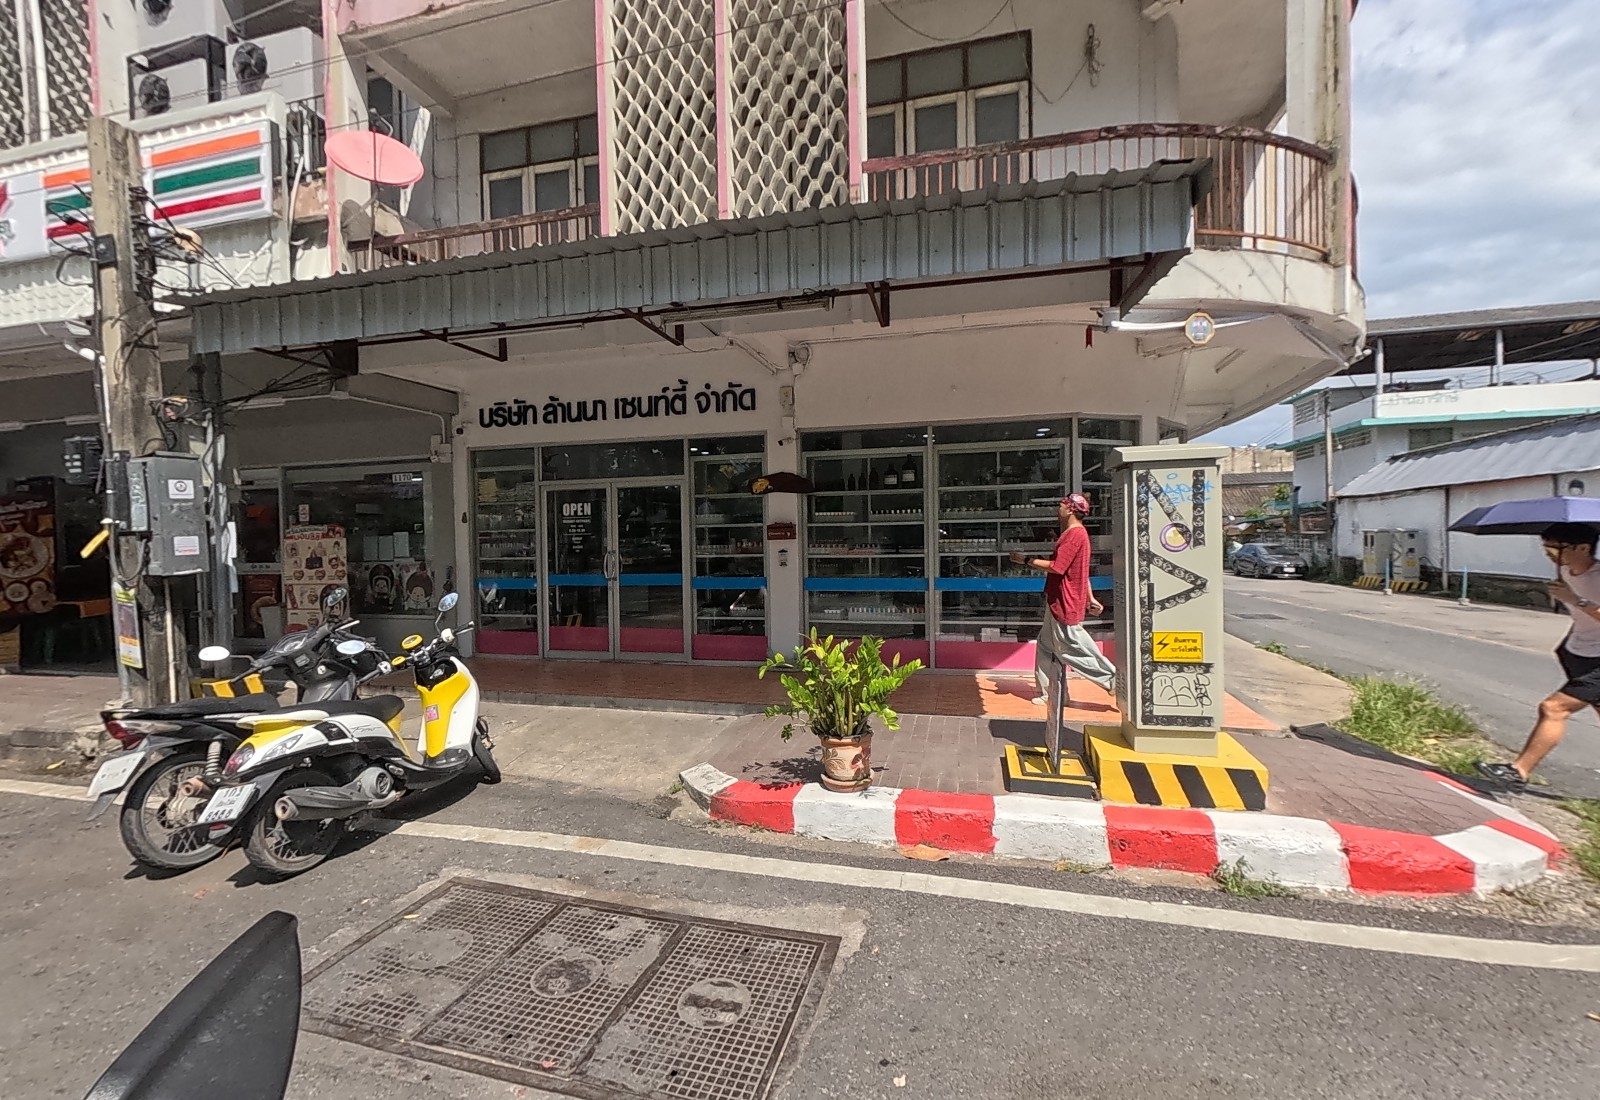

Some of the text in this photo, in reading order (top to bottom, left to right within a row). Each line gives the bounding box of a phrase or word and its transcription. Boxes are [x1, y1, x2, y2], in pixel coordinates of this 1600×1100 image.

[478, 399, 538, 429] บริษัท
[542, 395, 607, 424] ล้านนา
[694, 382, 757, 415] จำกัด
[562, 502, 592, 516] OPEN
